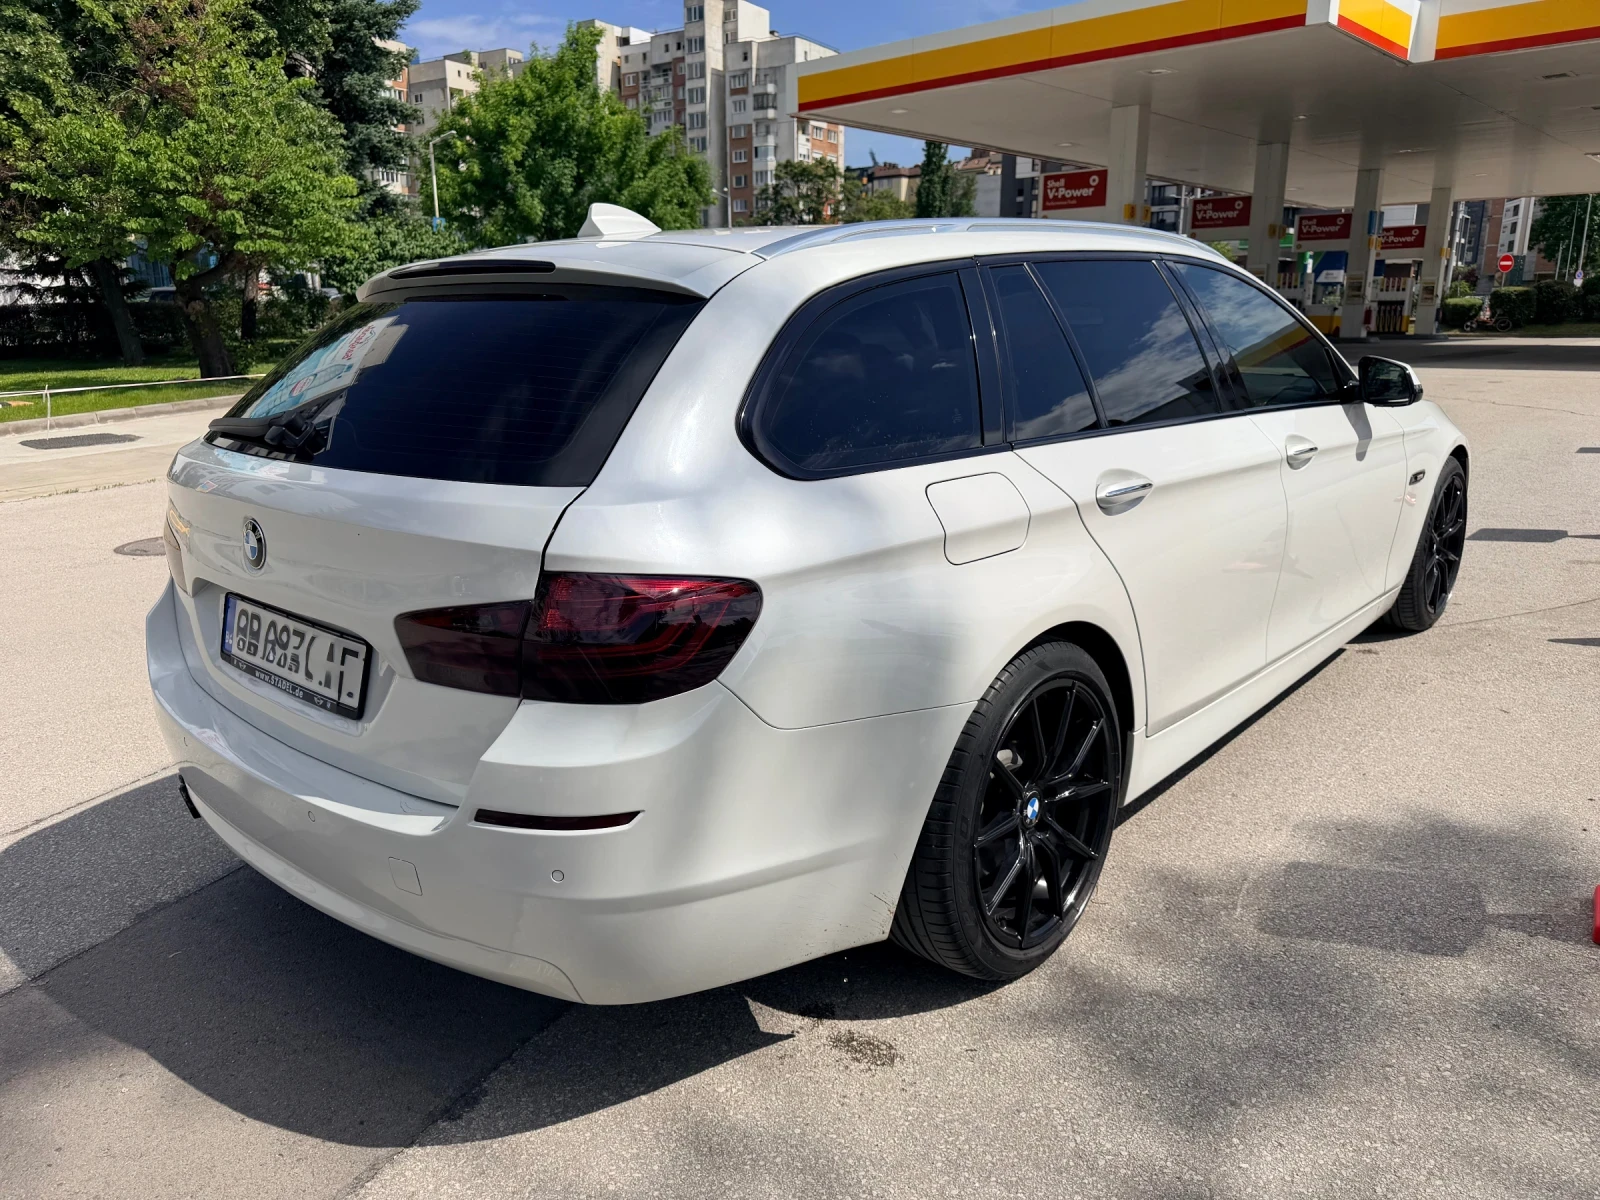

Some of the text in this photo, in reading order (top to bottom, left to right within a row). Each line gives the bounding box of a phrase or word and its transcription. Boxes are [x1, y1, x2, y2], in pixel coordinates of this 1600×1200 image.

[1047, 178, 1066, 188] Shell
[1047, 187, 1095, 199] V-Power
[1196, 202, 1213, 211] Shell
[1196, 210, 1239, 220] V-Power
[1301, 225, 1341, 233] V-Power
